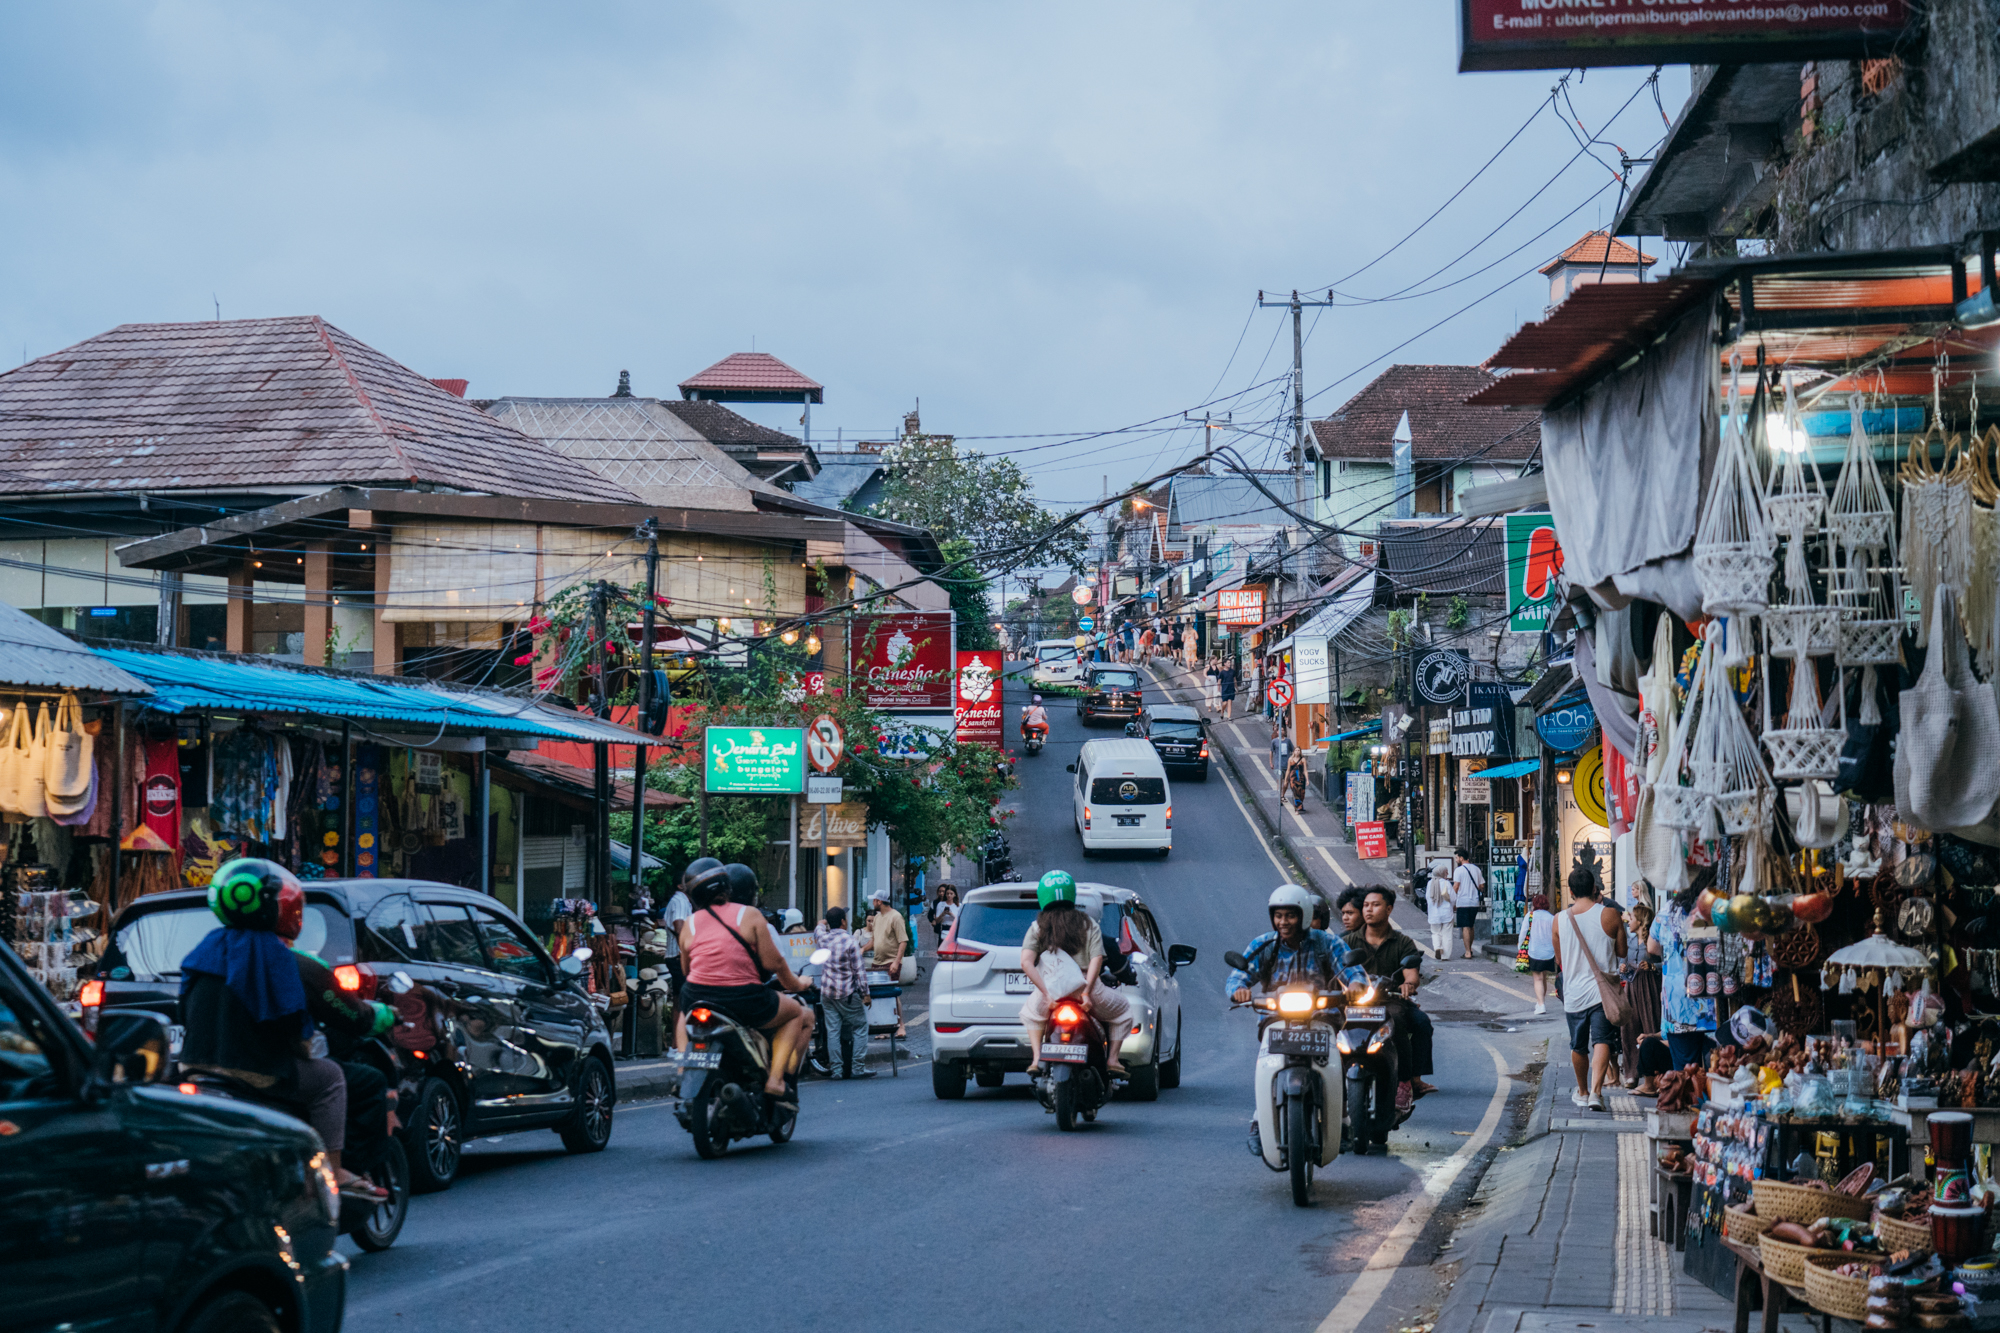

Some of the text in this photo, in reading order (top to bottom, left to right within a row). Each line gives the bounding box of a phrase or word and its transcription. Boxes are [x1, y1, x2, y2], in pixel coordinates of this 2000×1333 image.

[1493, 13, 1542, 29] E-mail
[1220, 592, 1261, 607] NEW DELHI
[1220, 608, 1261, 622] INDIAN FOOD
[1299, 658, 1325, 666] SUCKS
[1426, 654, 1443, 664] TINO
[954, 705, 1001, 721] Ganesha
[713, 738, 797, 757] Wenara Bali
[820, 727, 833, 759] P
[807, 810, 860, 840] Olive
[1008, 974, 1020, 985] DK
[1271, 1031, 1327, 1043] DK 2245 LZ
